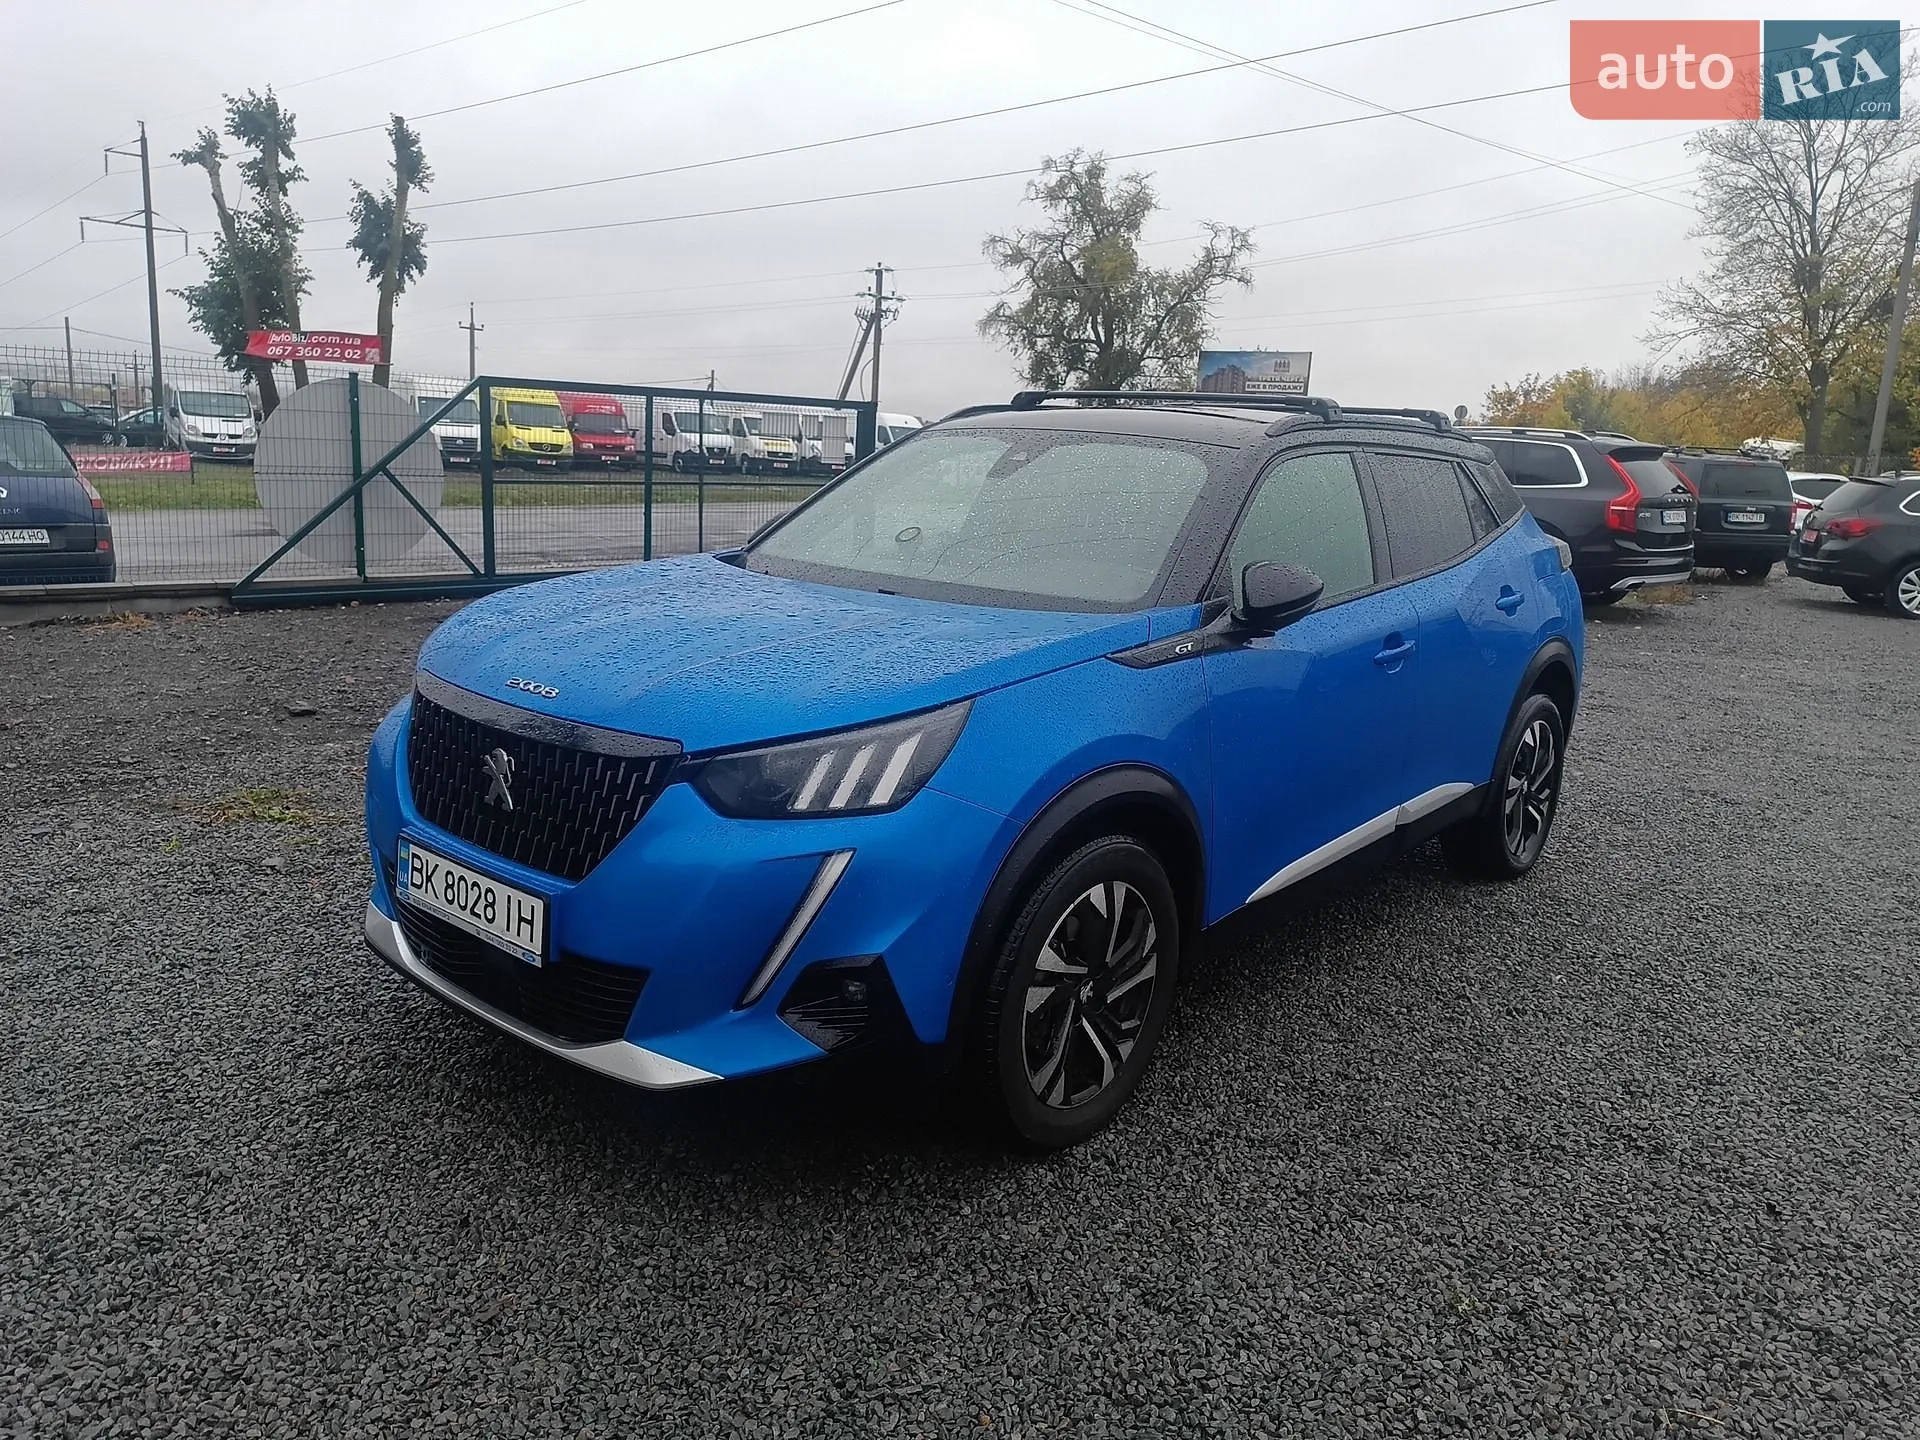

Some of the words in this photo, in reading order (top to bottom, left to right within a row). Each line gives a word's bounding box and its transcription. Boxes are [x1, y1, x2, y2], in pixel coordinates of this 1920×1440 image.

[267, 346, 292, 356] 067
[296, 347, 320, 357] 360
[324, 348, 341, 358] 22
[344, 348, 361, 359] 02
[76, 455, 172, 470] ВТОВИКУП
[1175, 642, 1194, 655] GT
[504, 676, 560, 699] 2008
[400, 870, 408, 885] UA
[410, 852, 440, 900] BK
[443, 869, 497, 924] 8028
[505, 894, 535, 943] IH
